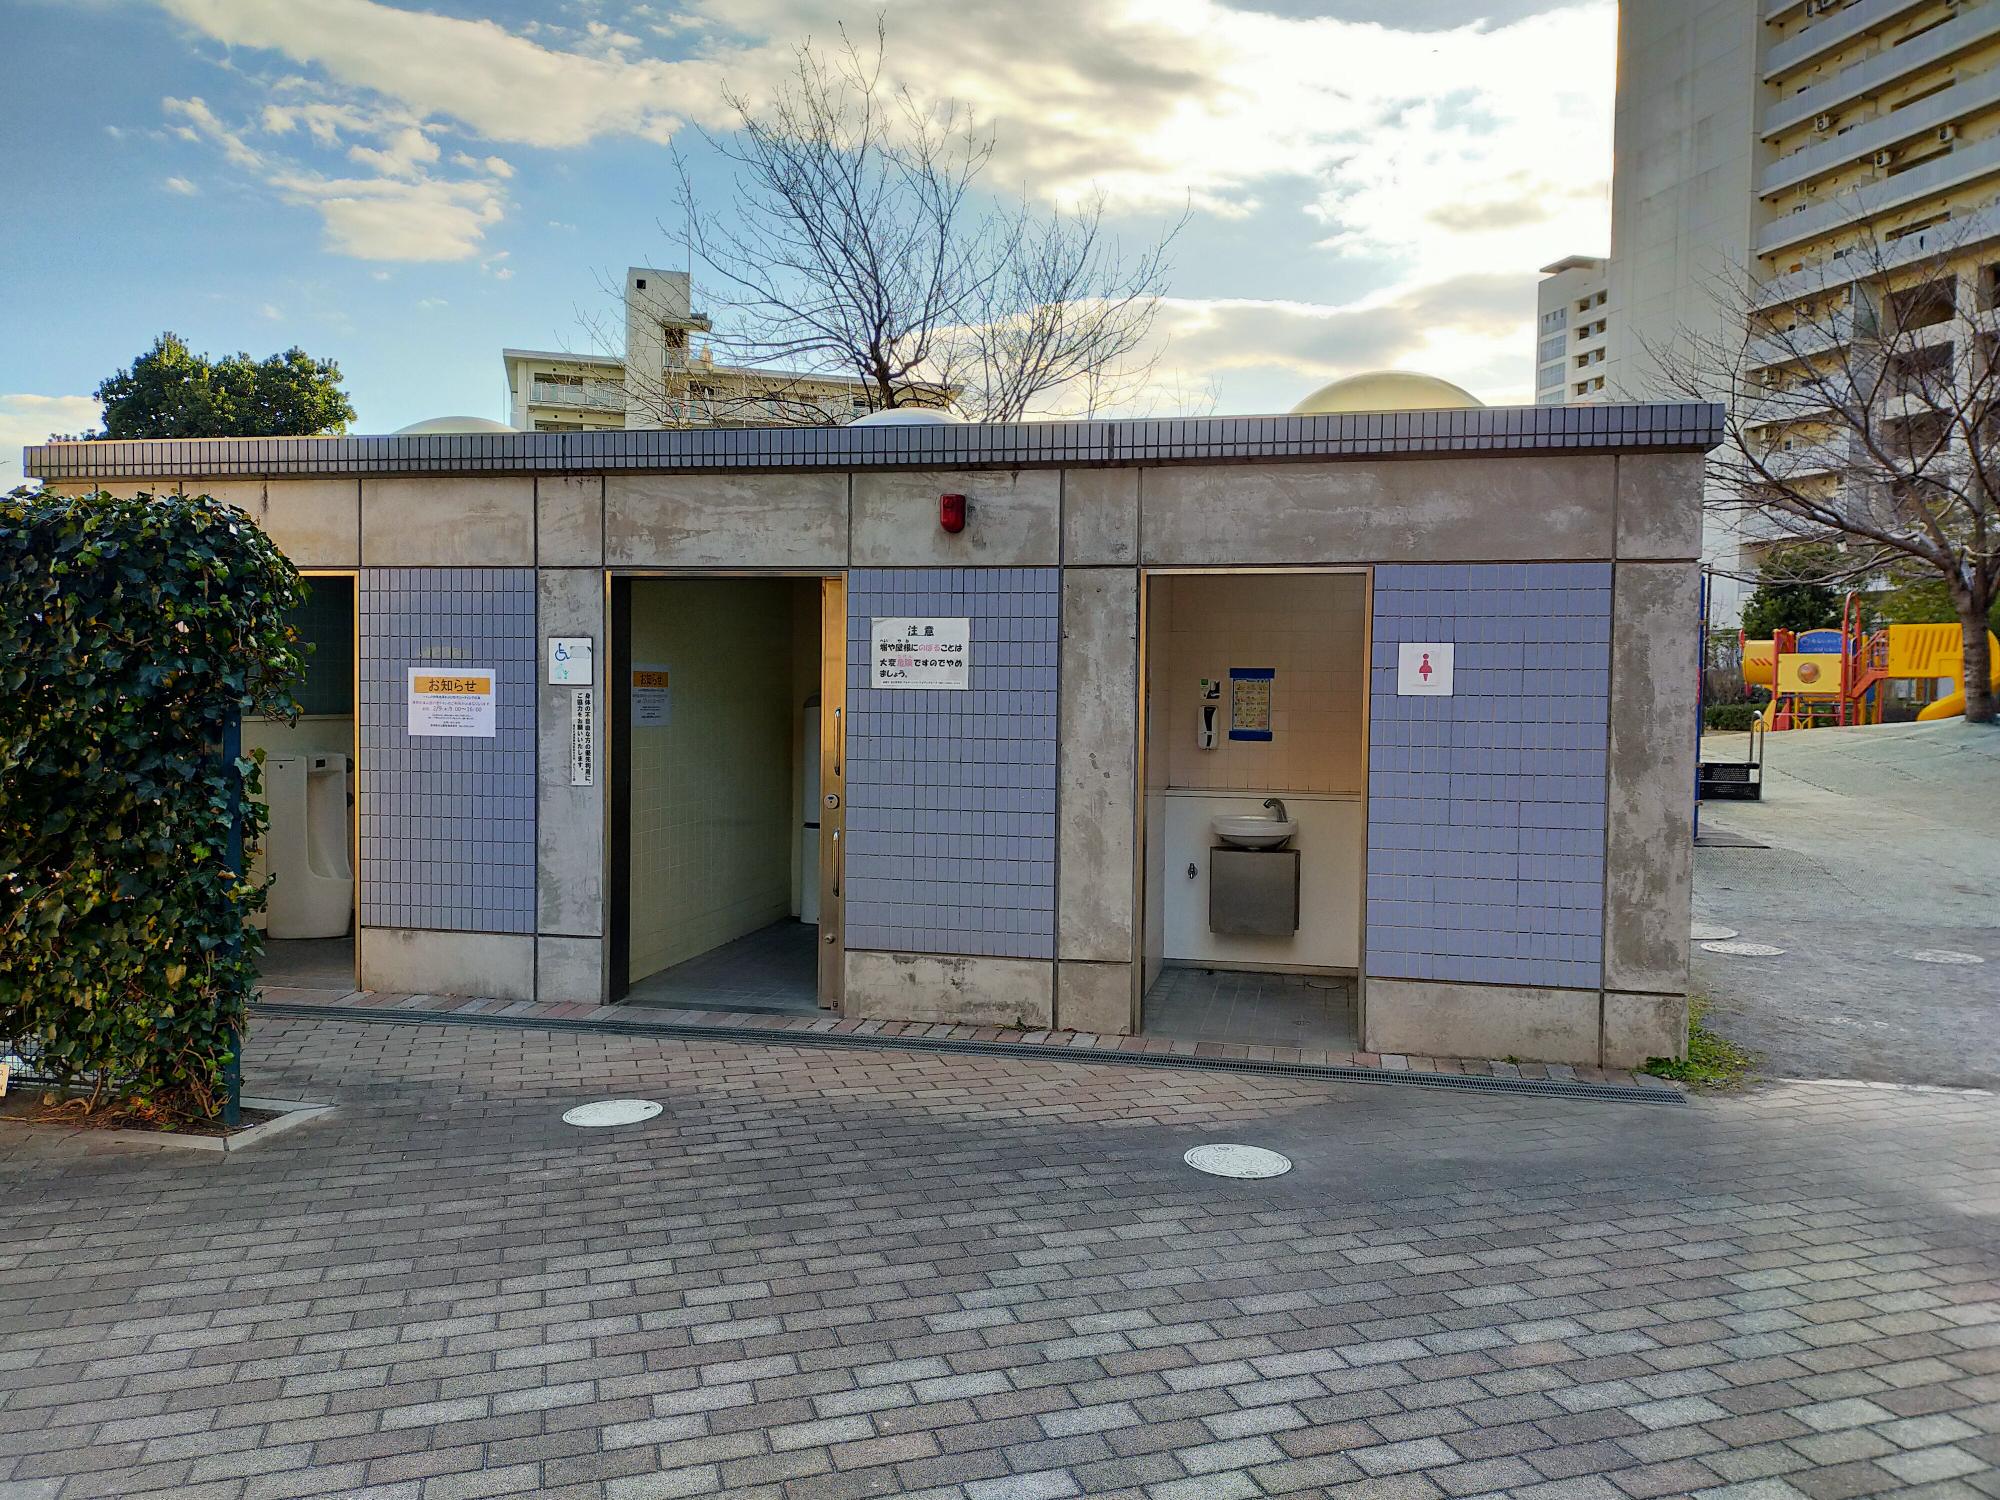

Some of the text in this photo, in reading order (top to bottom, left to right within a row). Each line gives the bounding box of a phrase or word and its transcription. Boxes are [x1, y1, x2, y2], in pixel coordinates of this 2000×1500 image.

[908, 625, 935, 636] 注意
[880, 670, 908, 678] ましょう。
[428, 678, 477, 692] お知らせ
